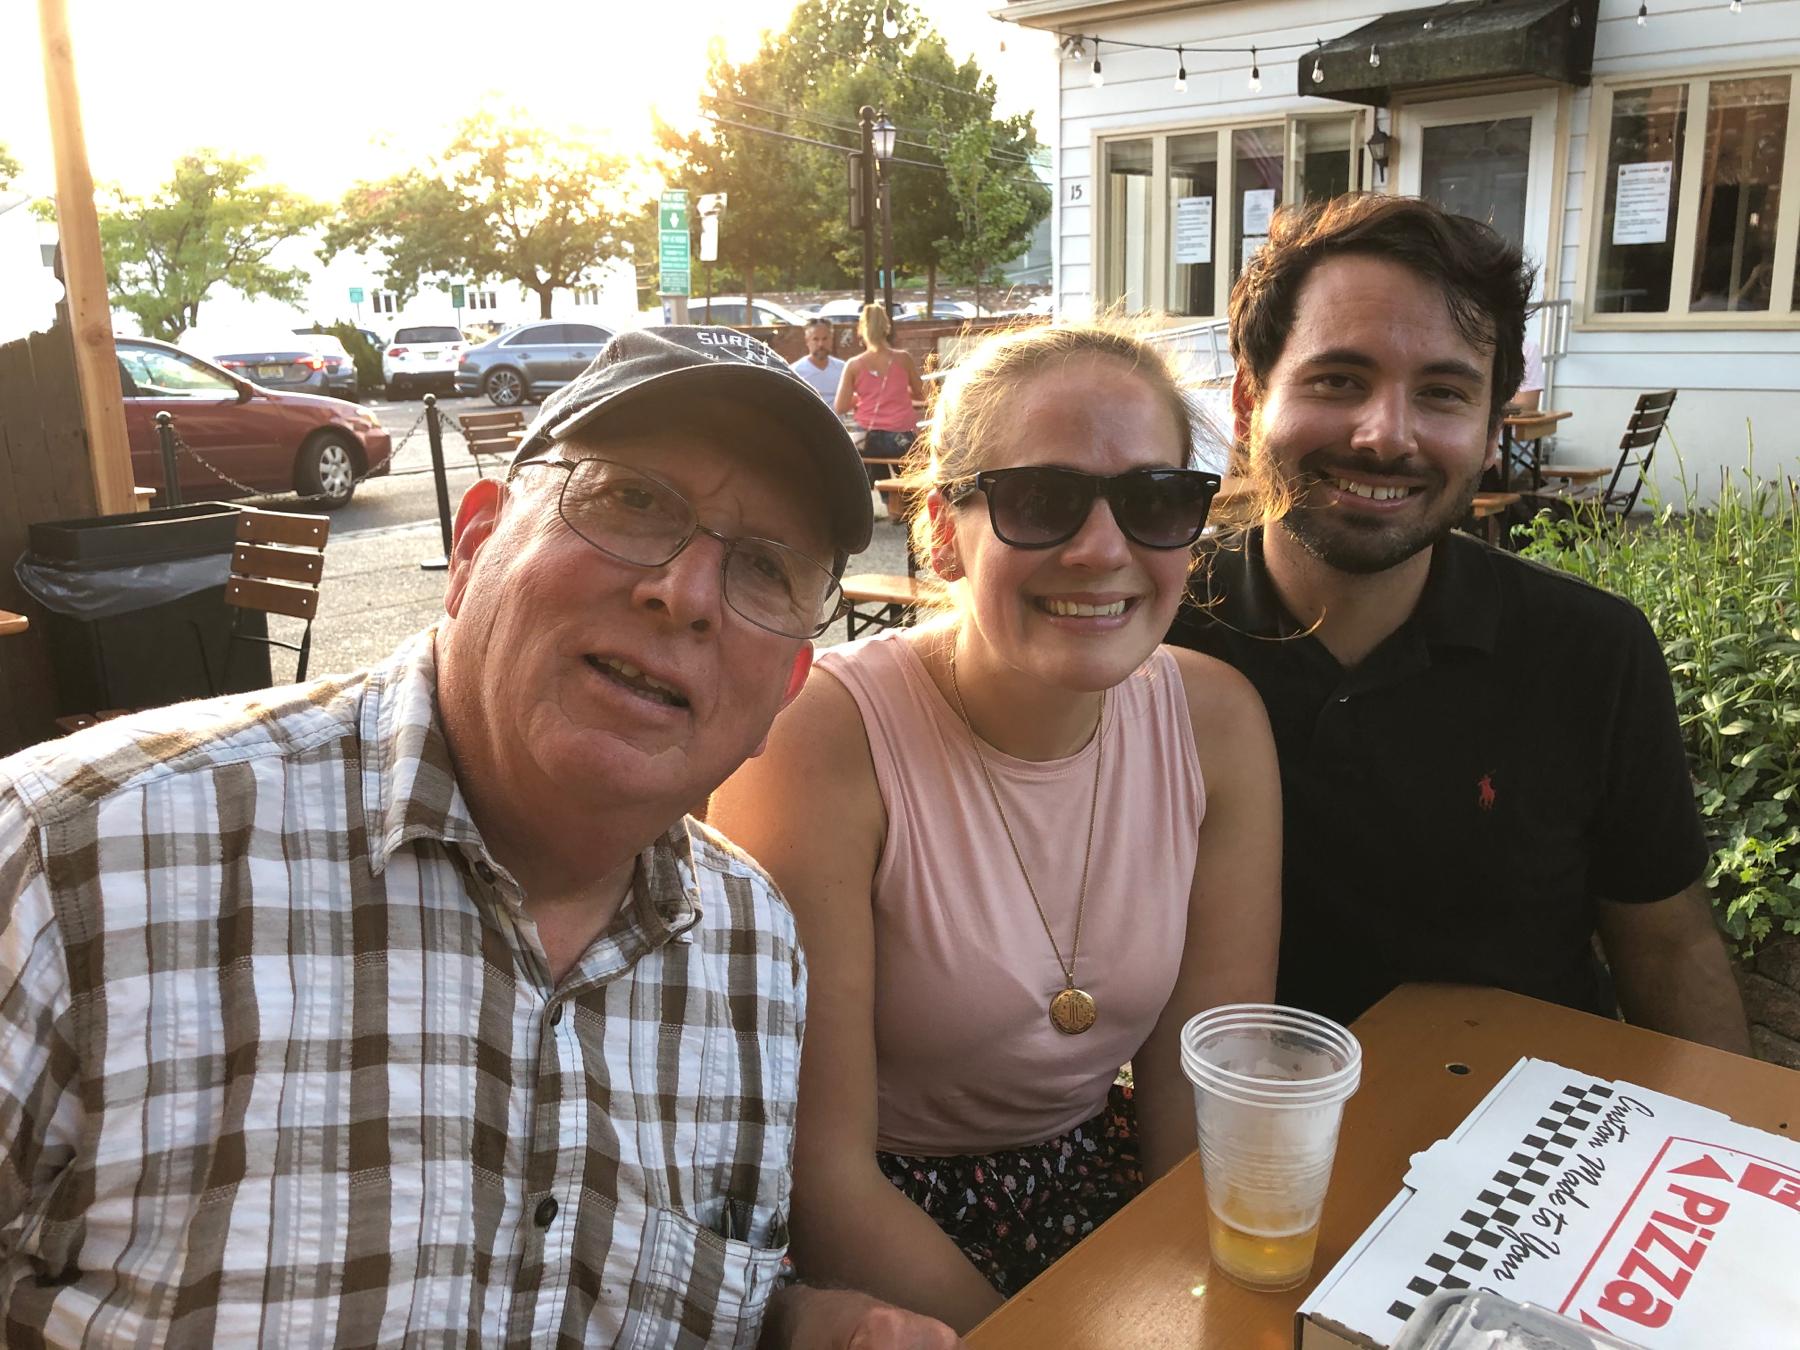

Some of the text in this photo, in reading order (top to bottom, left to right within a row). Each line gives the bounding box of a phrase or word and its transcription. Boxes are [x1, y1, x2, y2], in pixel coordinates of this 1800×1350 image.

[1070, 184, 1082, 200] 15
[1493, 1095, 1655, 1281] Custom Made to Your
